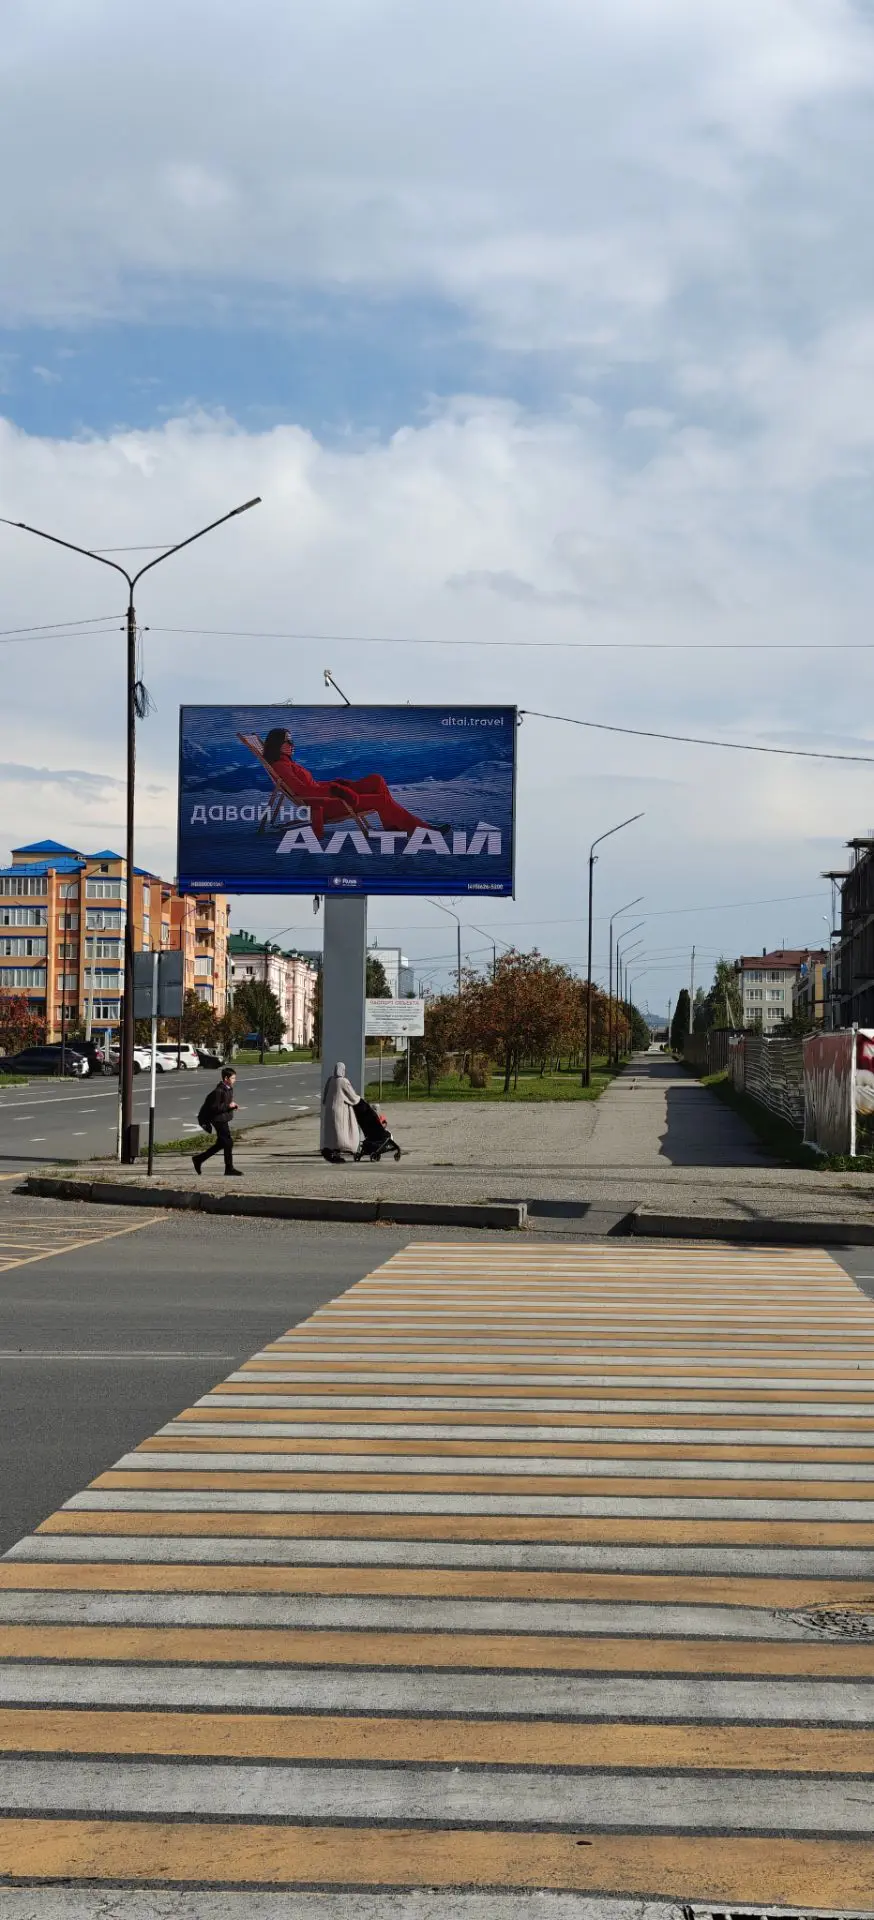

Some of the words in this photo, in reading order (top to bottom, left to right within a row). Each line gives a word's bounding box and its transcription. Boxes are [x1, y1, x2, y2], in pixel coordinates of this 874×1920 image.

[441, 716, 504, 726] altai.travel
[191, 801, 272, 824] давай
[281, 804, 312, 821] на
[275, 821, 502, 855] АЛТАЙ
